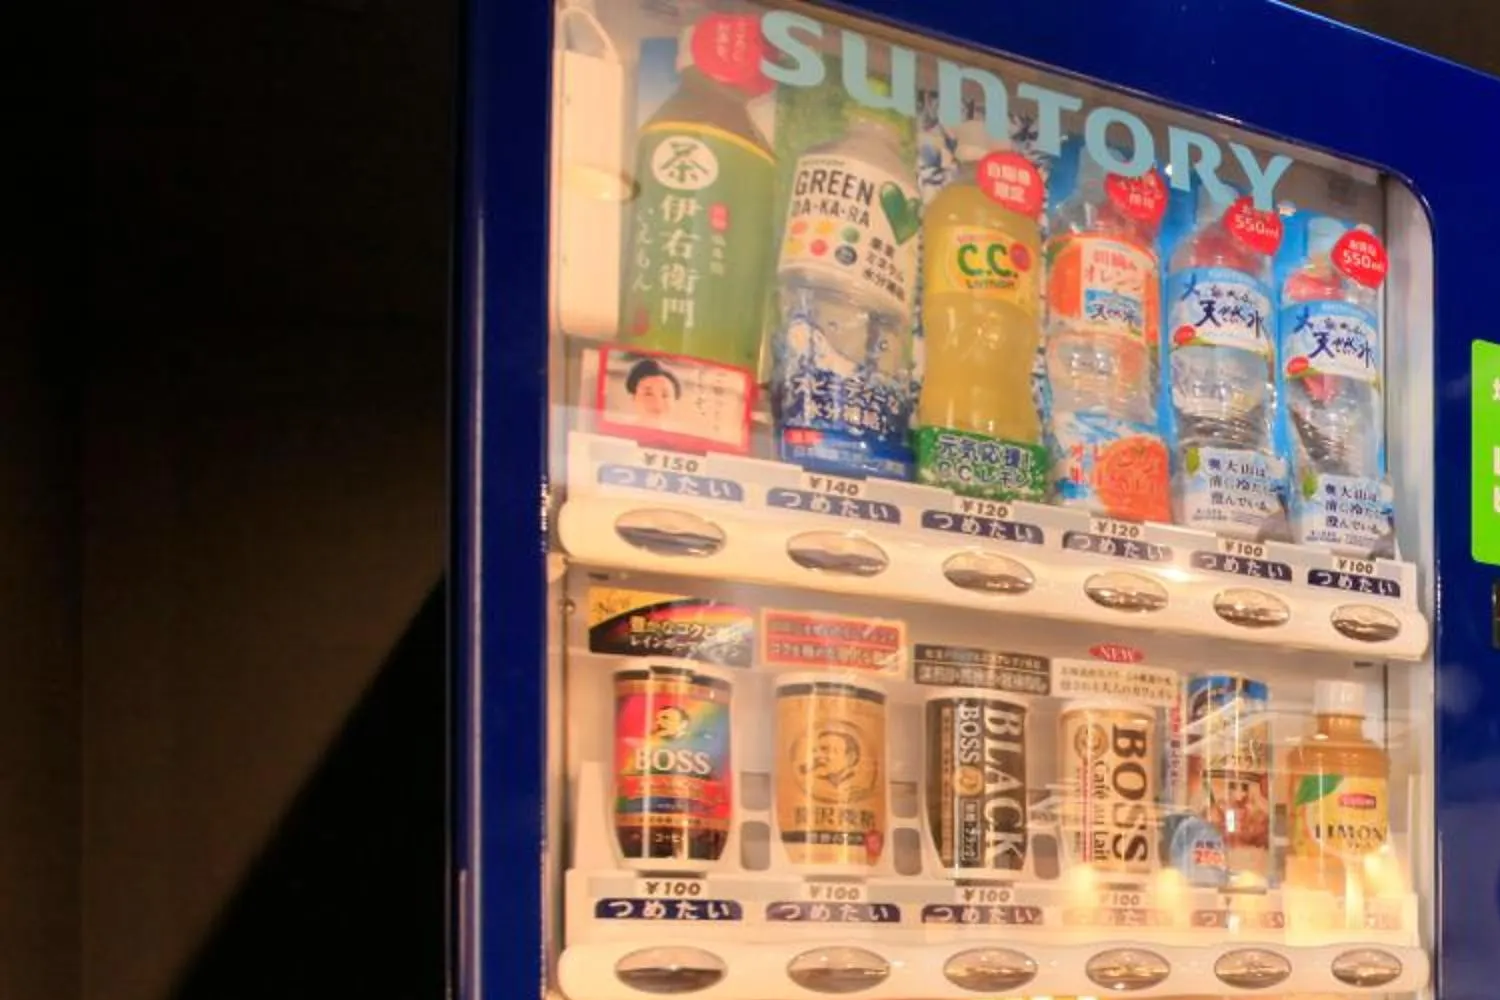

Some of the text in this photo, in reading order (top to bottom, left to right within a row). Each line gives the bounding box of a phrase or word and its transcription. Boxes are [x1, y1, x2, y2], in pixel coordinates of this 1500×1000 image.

[760, 9, 1292, 211] SUNTORY
[659, 140, 709, 182] 茶
[794, 168, 875, 206] GREEN
[660, 194, 701, 328] 伊右衛門
[612, 467, 734, 500] つめたい
[780, 490, 889, 520] つめたい
[932, 513, 1033, 541] つめたい
[1200, 555, 1284, 578] つめたい
[1317, 572, 1394, 595] つめたい
[959, 701, 982, 763] BOSS
[634, 748, 712, 775] BOSS
[984, 705, 1023, 867] BLACK
[1112, 723, 1148, 862] BOSS
[645, 882, 700, 896] ¥100
[608, 901, 729, 918] つめたい
[780, 904, 888, 921] つめたい
